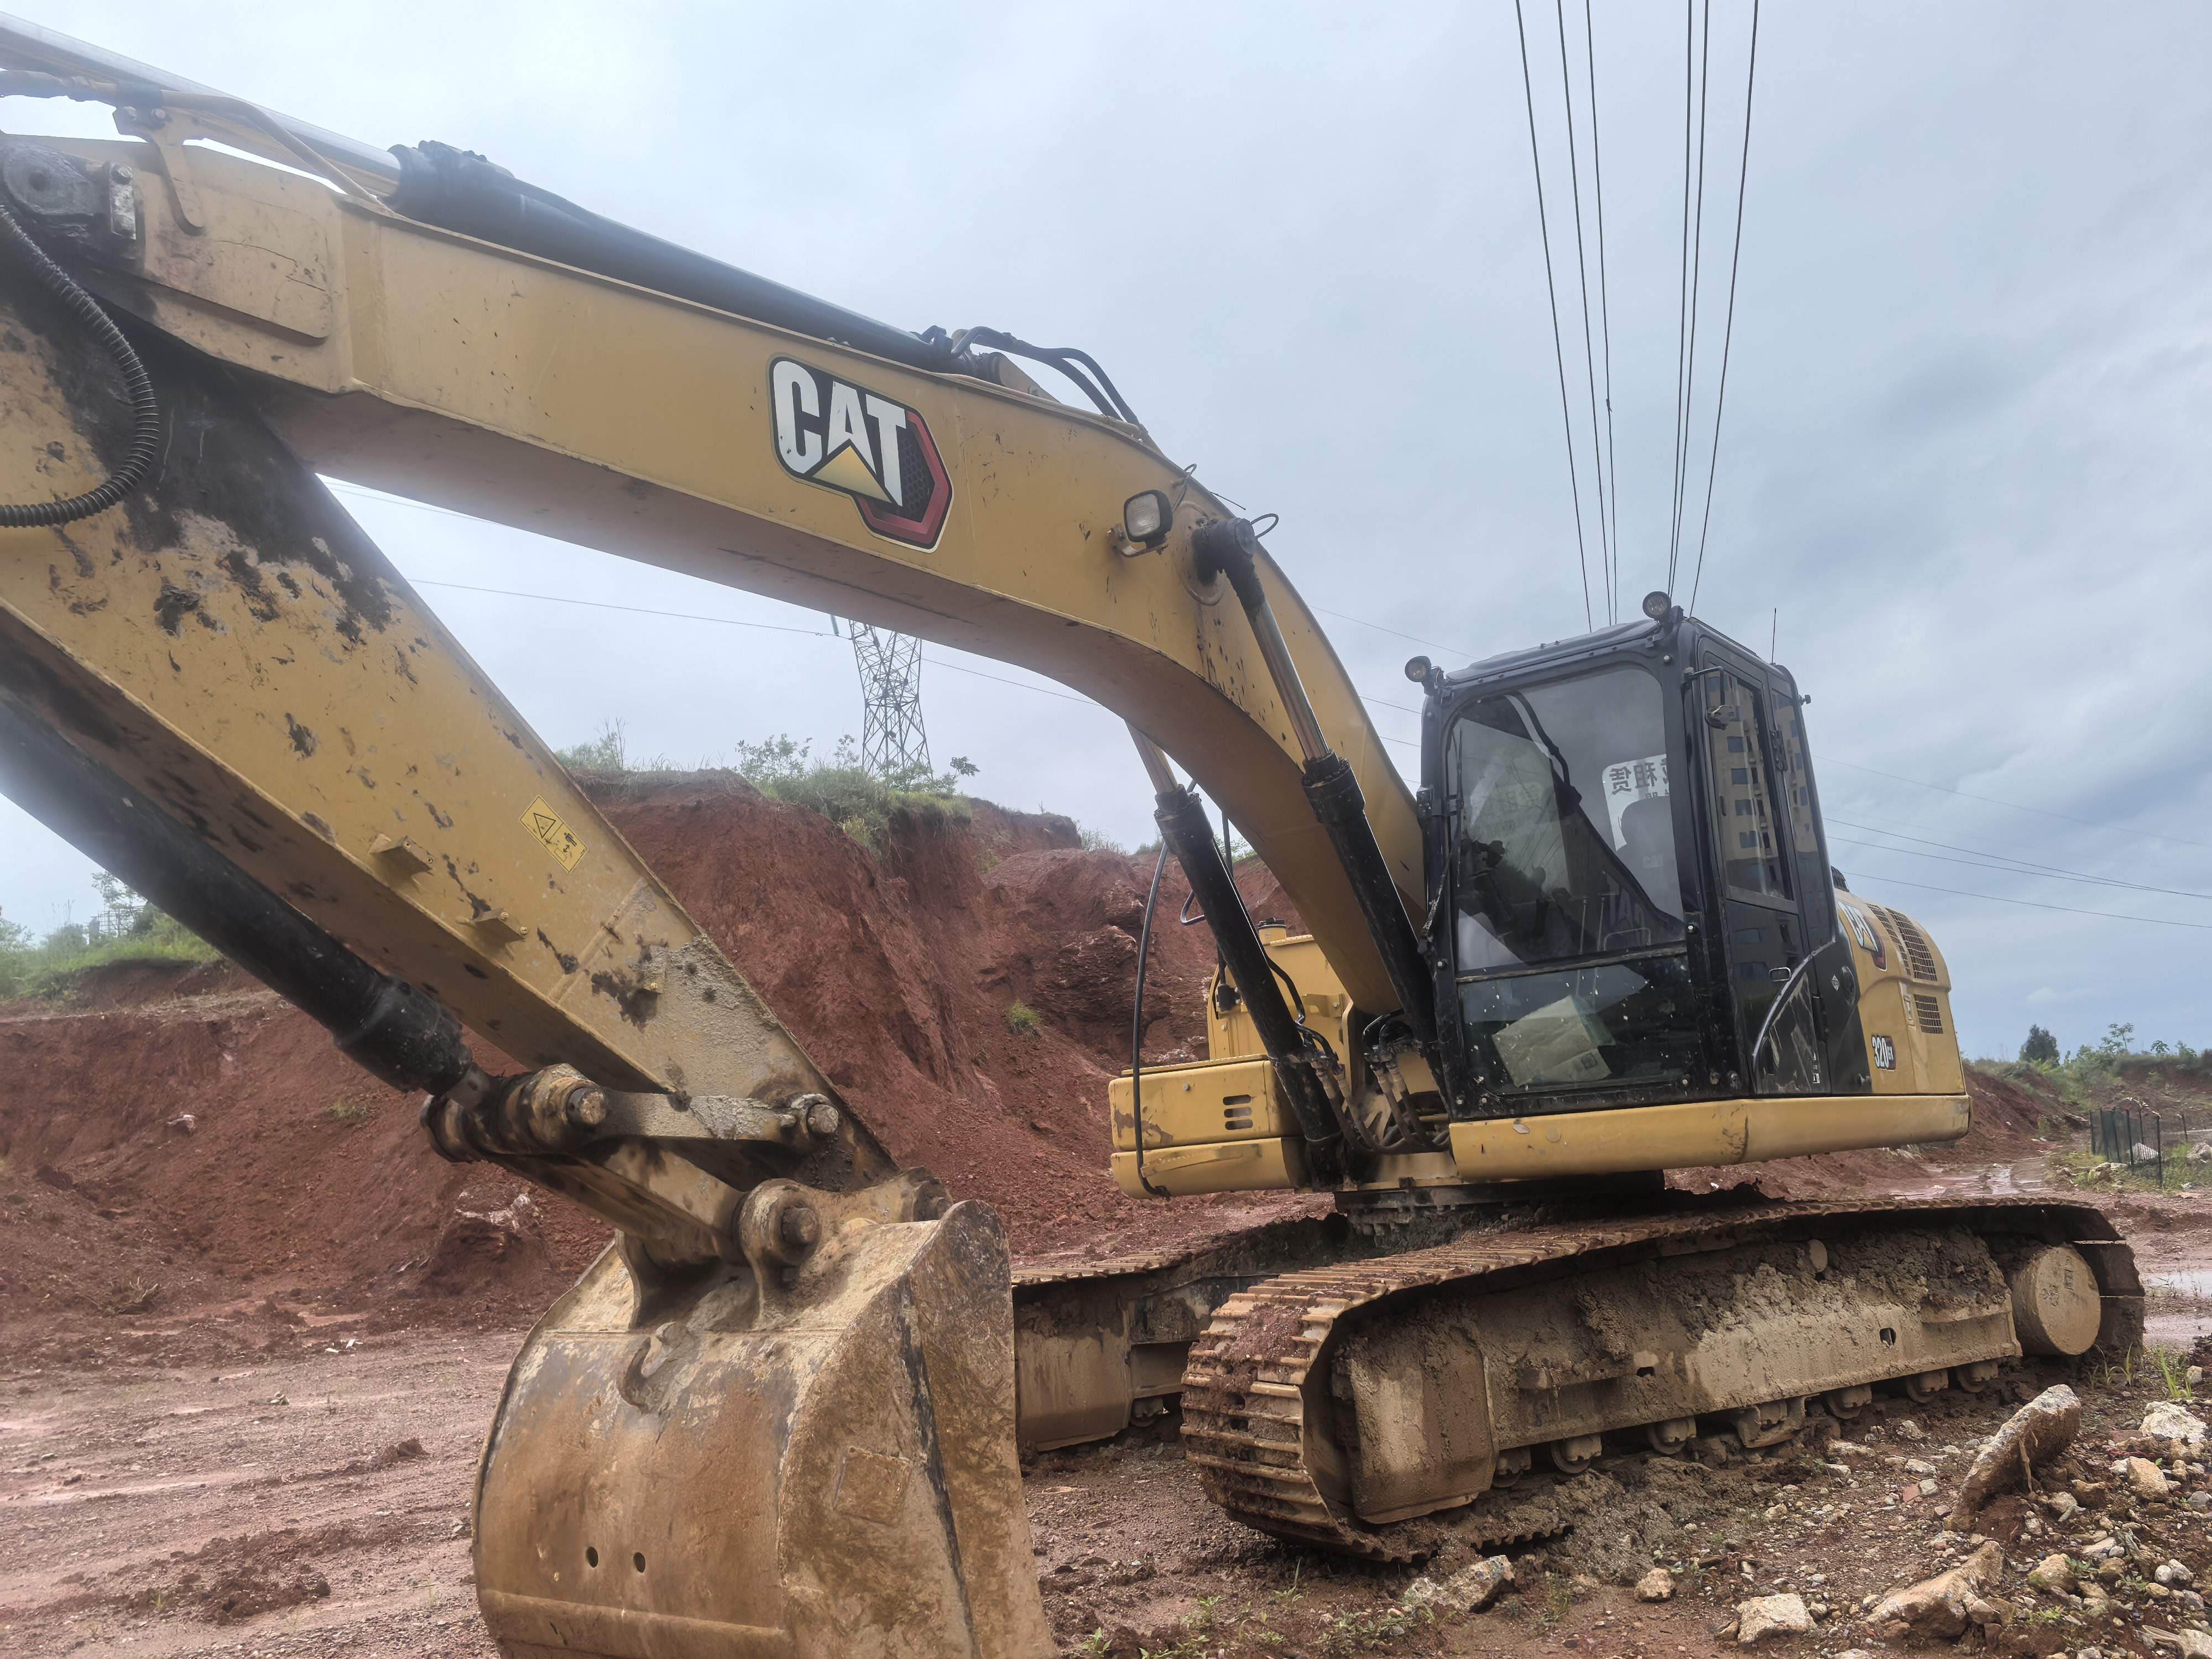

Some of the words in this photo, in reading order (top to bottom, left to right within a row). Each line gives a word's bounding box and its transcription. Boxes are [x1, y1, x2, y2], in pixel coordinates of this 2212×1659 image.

[774, 361, 907, 507] CAT
[1837, 900, 1879, 952] CAT
[1872, 1036, 1889, 1068] 320
